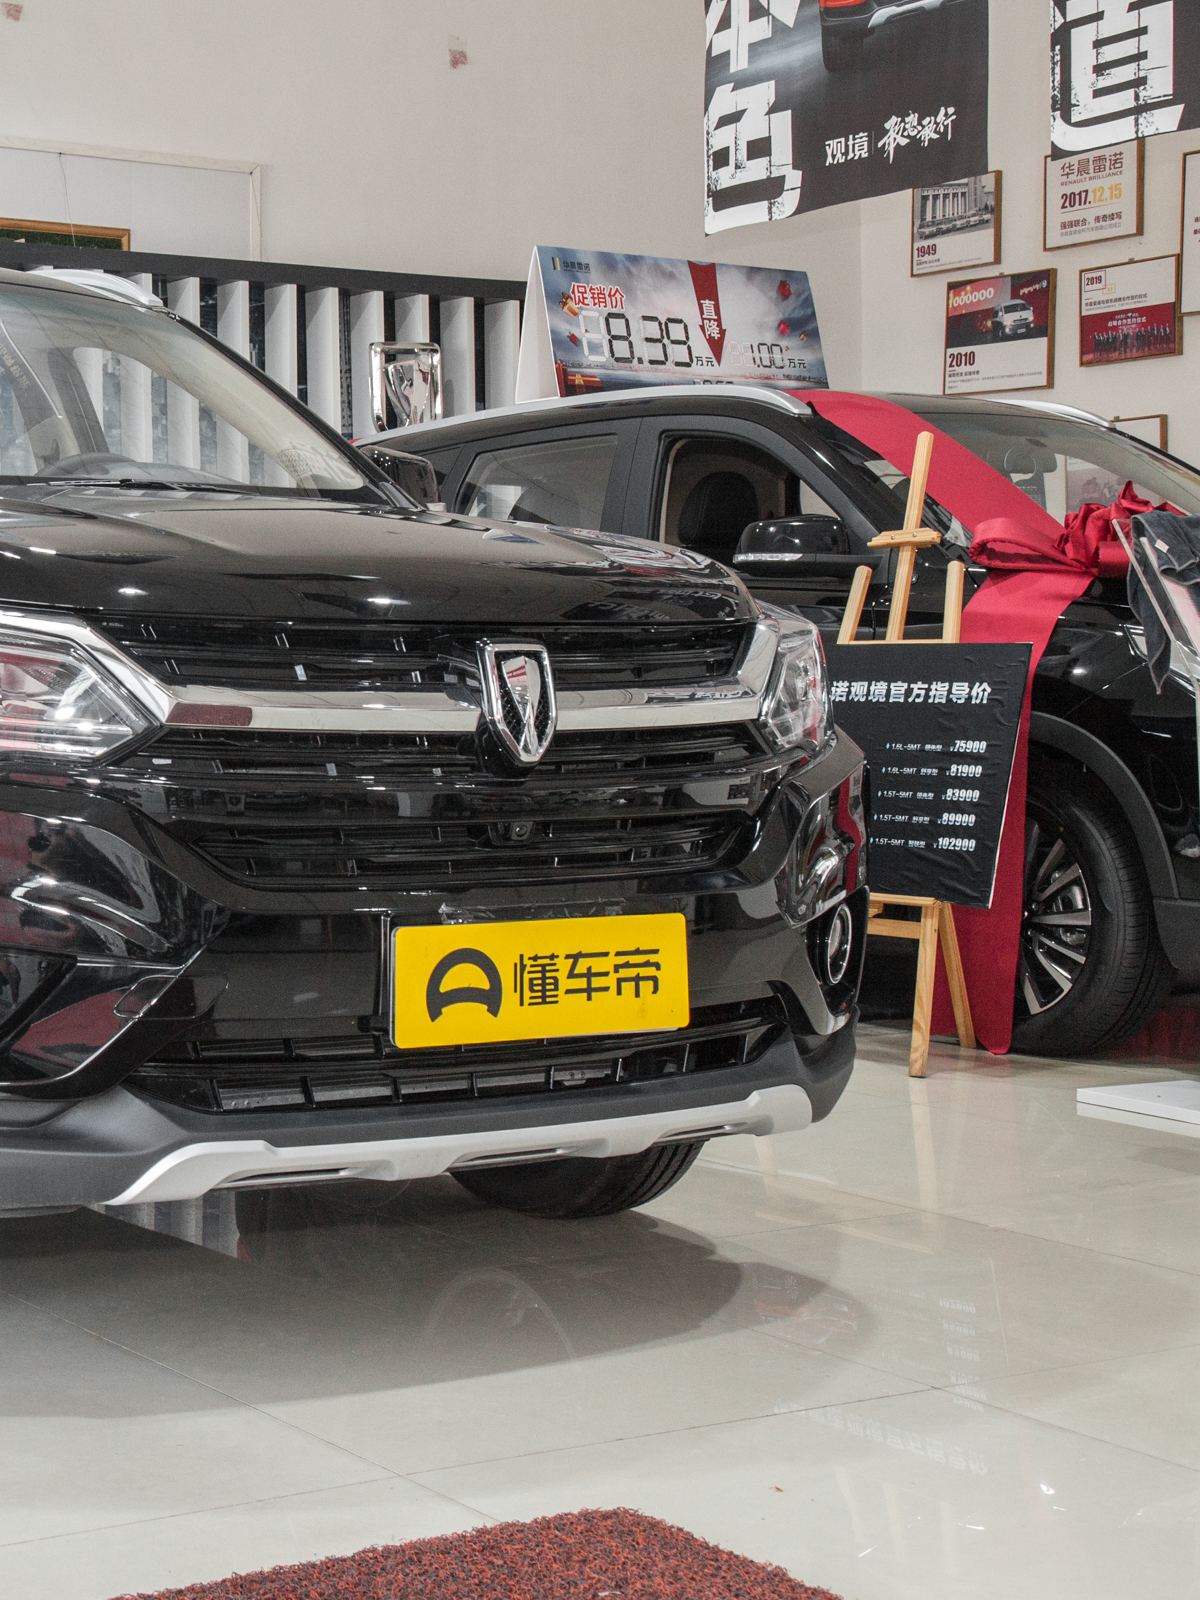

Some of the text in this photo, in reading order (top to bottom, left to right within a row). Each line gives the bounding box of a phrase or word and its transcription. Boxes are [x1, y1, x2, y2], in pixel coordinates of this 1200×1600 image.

[825, 106, 957, 166] 观境 敢想敢行
[1060, 151, 1124, 179] 华晨雷诺
[1060, 170, 1123, 186] RENAULT BRILLIANCE
[1060, 183, 1123, 209] 2017.12.15
[916, 243, 937, 258] 1949
[1086, 275, 1102, 286] 2019
[571, 283, 625, 310] 促销价
[700, 299, 721, 340] 直降
[694, 355, 715, 368] 万元
[787, 357, 808, 370] 万元
[948, 351, 976, 368] 2010
[513, 946, 662, 1007] 懂车帝
